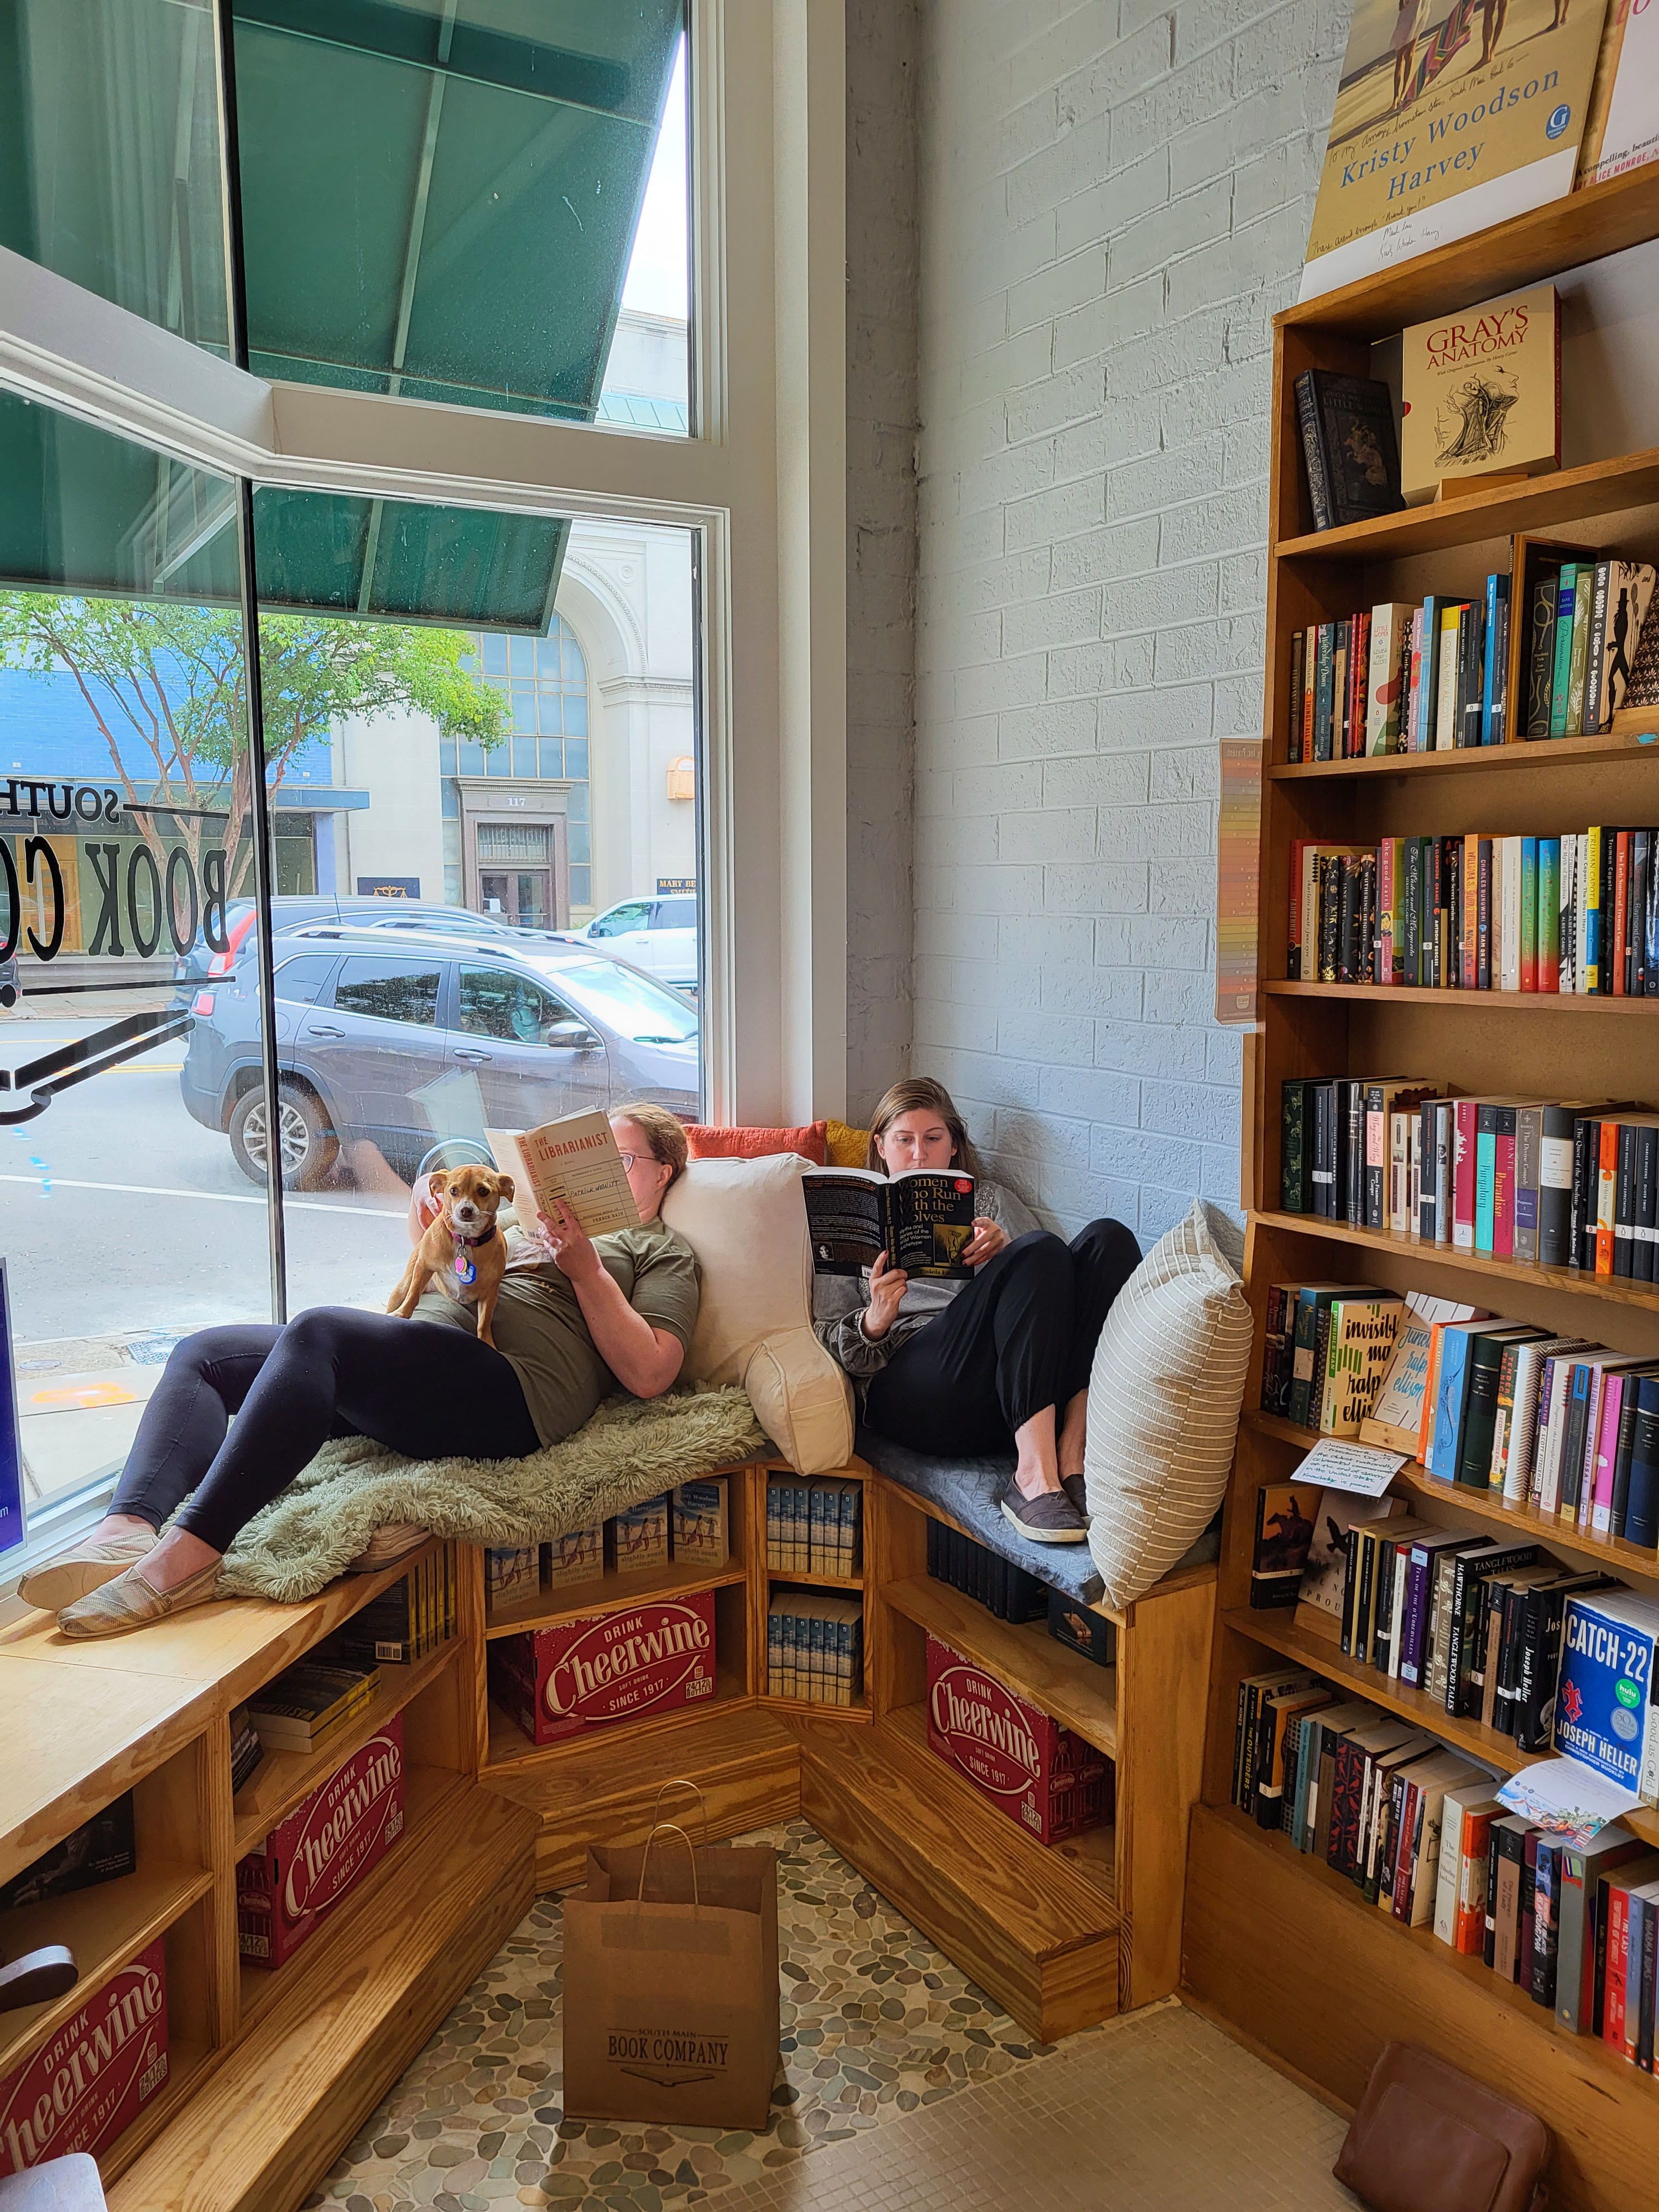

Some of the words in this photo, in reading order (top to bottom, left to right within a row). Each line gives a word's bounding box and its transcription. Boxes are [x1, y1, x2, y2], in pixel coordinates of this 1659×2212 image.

[1340, 137, 1416, 188] Kristy
[1428, 70, 1559, 144] Woodson
[1386, 142, 1485, 201] Harvey
[1584, 150, 1629, 174] compelling,
[1425, 305, 1530, 354] GRAY'S
[1425, 327, 1530, 371] ANATOMY
[1321, 635, 1332, 666] Watership
[1443, 636, 1452, 669] LOUISA
[1321, 666, 1330, 687] Down
[507, 796, 527, 807] 117
[517, 1136, 528, 1150] THE
[534, 1136, 549, 1149] THE
[538, 1131, 609, 1161] LIBRARIANIST
[522, 1146, 541, 1187] LIBRARIANIST
[570, 1187, 593, 1197] PATRICK
[933, 1187, 962, 1201] Run
[1477, 1165, 1490, 1208] Purgatory
[912, 1211, 945, 1223] olves
[914, 1199, 929, 1211] th
[932, 1199, 955, 1212] the
[900, 1226, 912, 1235] Myths
[900, 1232, 912, 1240] Stories
[900, 1241, 922, 1250] Archetype
[1345, 1314, 1399, 1340] invisibl
[1393, 1370, 1425, 1407] ellison
[1505, 1356, 1514, 1394] TENDER
[1591, 1371, 1599, 1390] JOHN
[1589, 1390, 1598, 1417] FOWLES
[1535, 1453, 1544, 1490] FITZGERALD
[1584, 1437, 1593, 1478] MANTISSA
[1474, 1551, 1533, 1571] TANGLEWOOD
[1454, 1563, 1464, 1616] HAWTHORNE
[603, 1615, 644, 1644] DRINK
[1449, 1627, 1459, 1684] TANGLEWOOD
[1524, 1646, 1535, 1678] Joseph
[1566, 1614, 1647, 1683] CATCH-22
[545, 1616, 711, 1715] Cheerwine
[609, 1690, 640, 1711] SINCE
[643, 1678, 664, 1697] 1917
[619, 1682, 632, 1691] SOFT
[633, 1673, 649, 1685] DRINK
[687, 1687, 712, 1697] BOTTLES
[966, 1677, 993, 1700] DRINK
[1522, 1678, 1532, 1703] Heller
[1619, 1684, 1636, 1697] hulu
[1447, 1685, 1455, 1710] TALES
[931, 1679, 1041, 1779] Cheerwine
[1557, 1719, 1597, 1754] JOSEPH
[1599, 1740, 1637, 1776] HELLER
[1564, 1744, 1600, 1766] CHRISTOPHER
[1601, 1764, 1625, 1780] BUCKLEY
[969, 1756, 989, 1778] SINCE
[991, 1768, 1006, 1786] 1917
[1244, 1740, 1252, 1790] OUTSIDERS
[327, 1763, 357, 1809] DRINK
[285, 1741, 402, 1919] Cheerwine
[1444, 1839, 1455, 1851] The
[332, 1853, 354, 1889] SINCE
[356, 1830, 371, 1857] 1917
[1438, 1870, 1457, 1888] Jackson
[1645, 1919, 1654, 1953] DHARMA
[1644, 1955, 1653, 1982] BUMS
[44, 2008, 91, 2075] DRINK
[609, 2036, 648, 2059] BOOK
[653, 2038, 728, 2065] COMPANY
